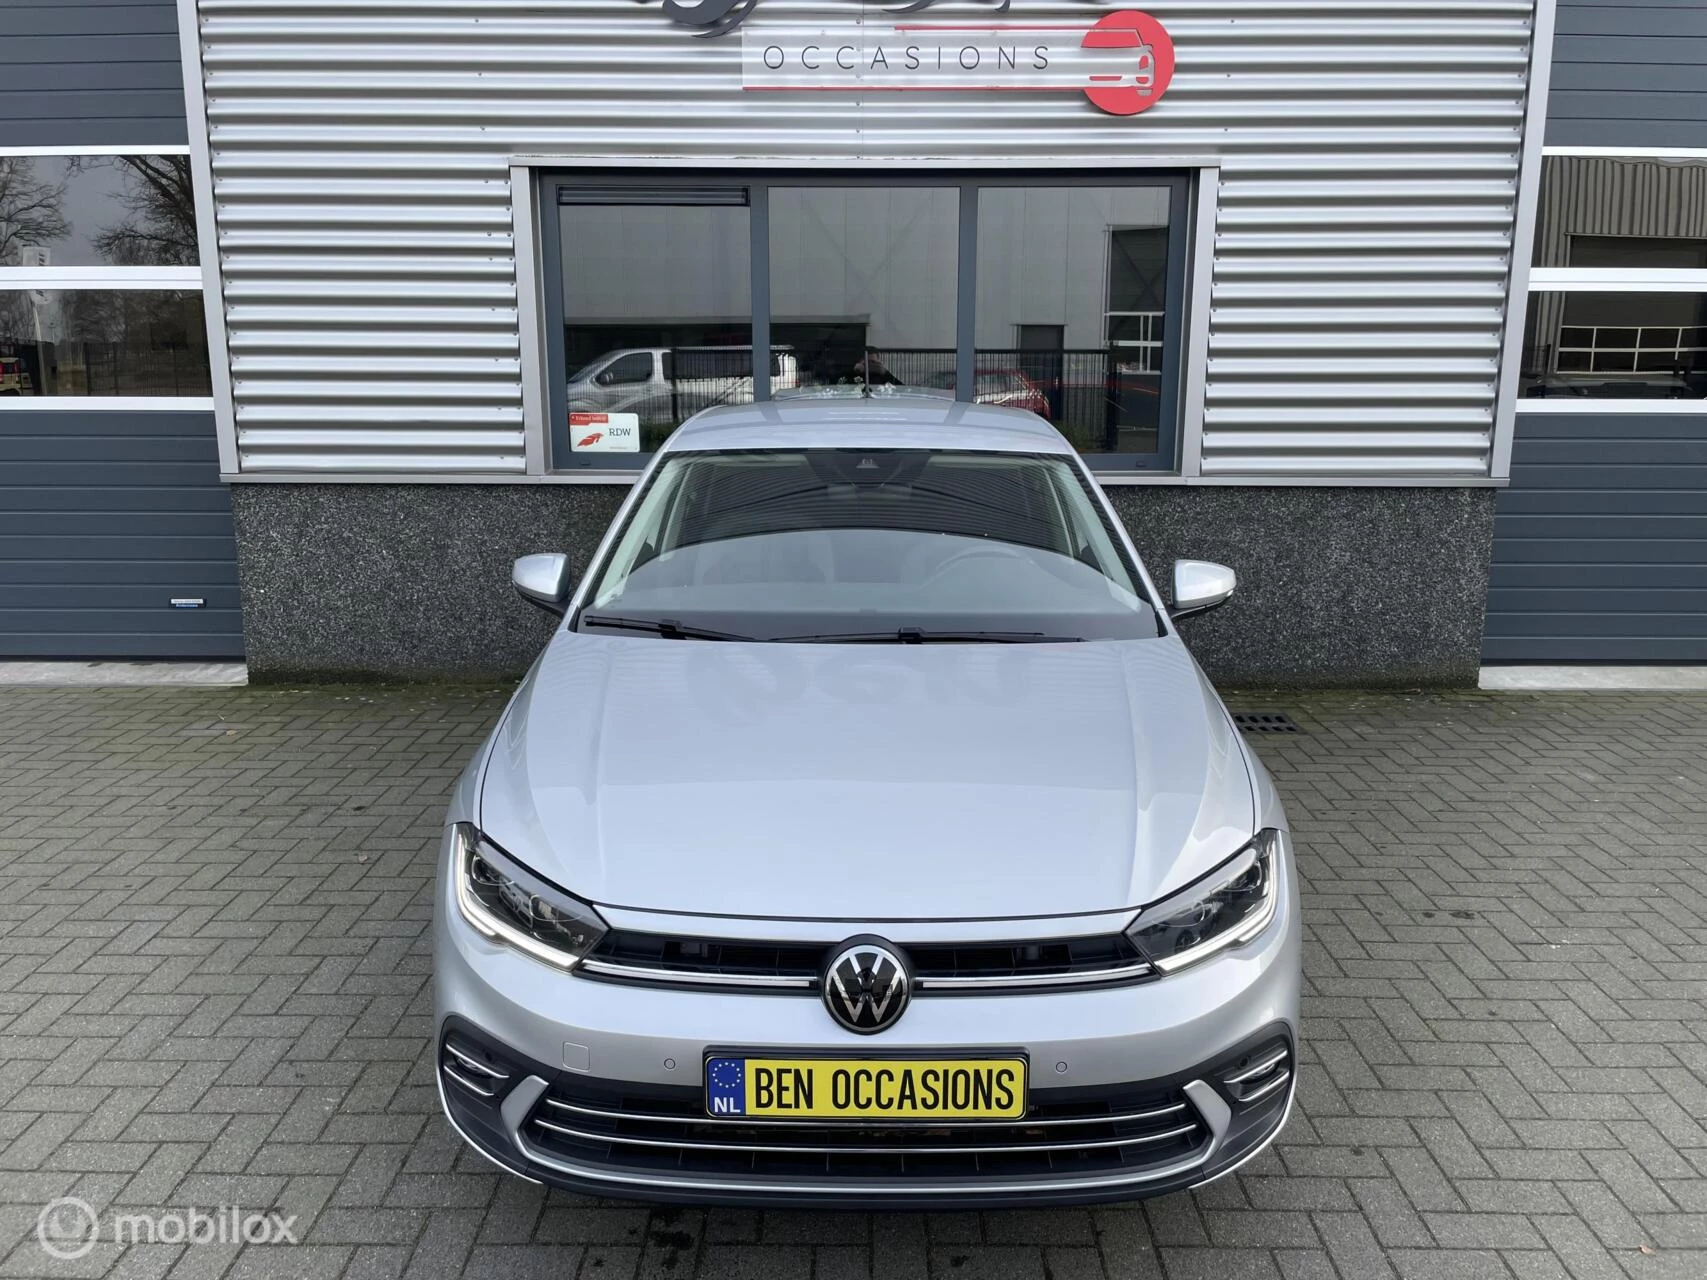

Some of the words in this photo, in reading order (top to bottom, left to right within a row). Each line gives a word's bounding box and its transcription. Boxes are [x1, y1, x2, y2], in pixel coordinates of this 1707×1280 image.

[762, 45, 1050, 71] OCCASIONS
[609, 428, 631, 437] RDW
[754, 1067, 814, 1110] BEN
[831, 1068, 1015, 1111] OCCASIONS
[714, 1097, 741, 1113] NL
